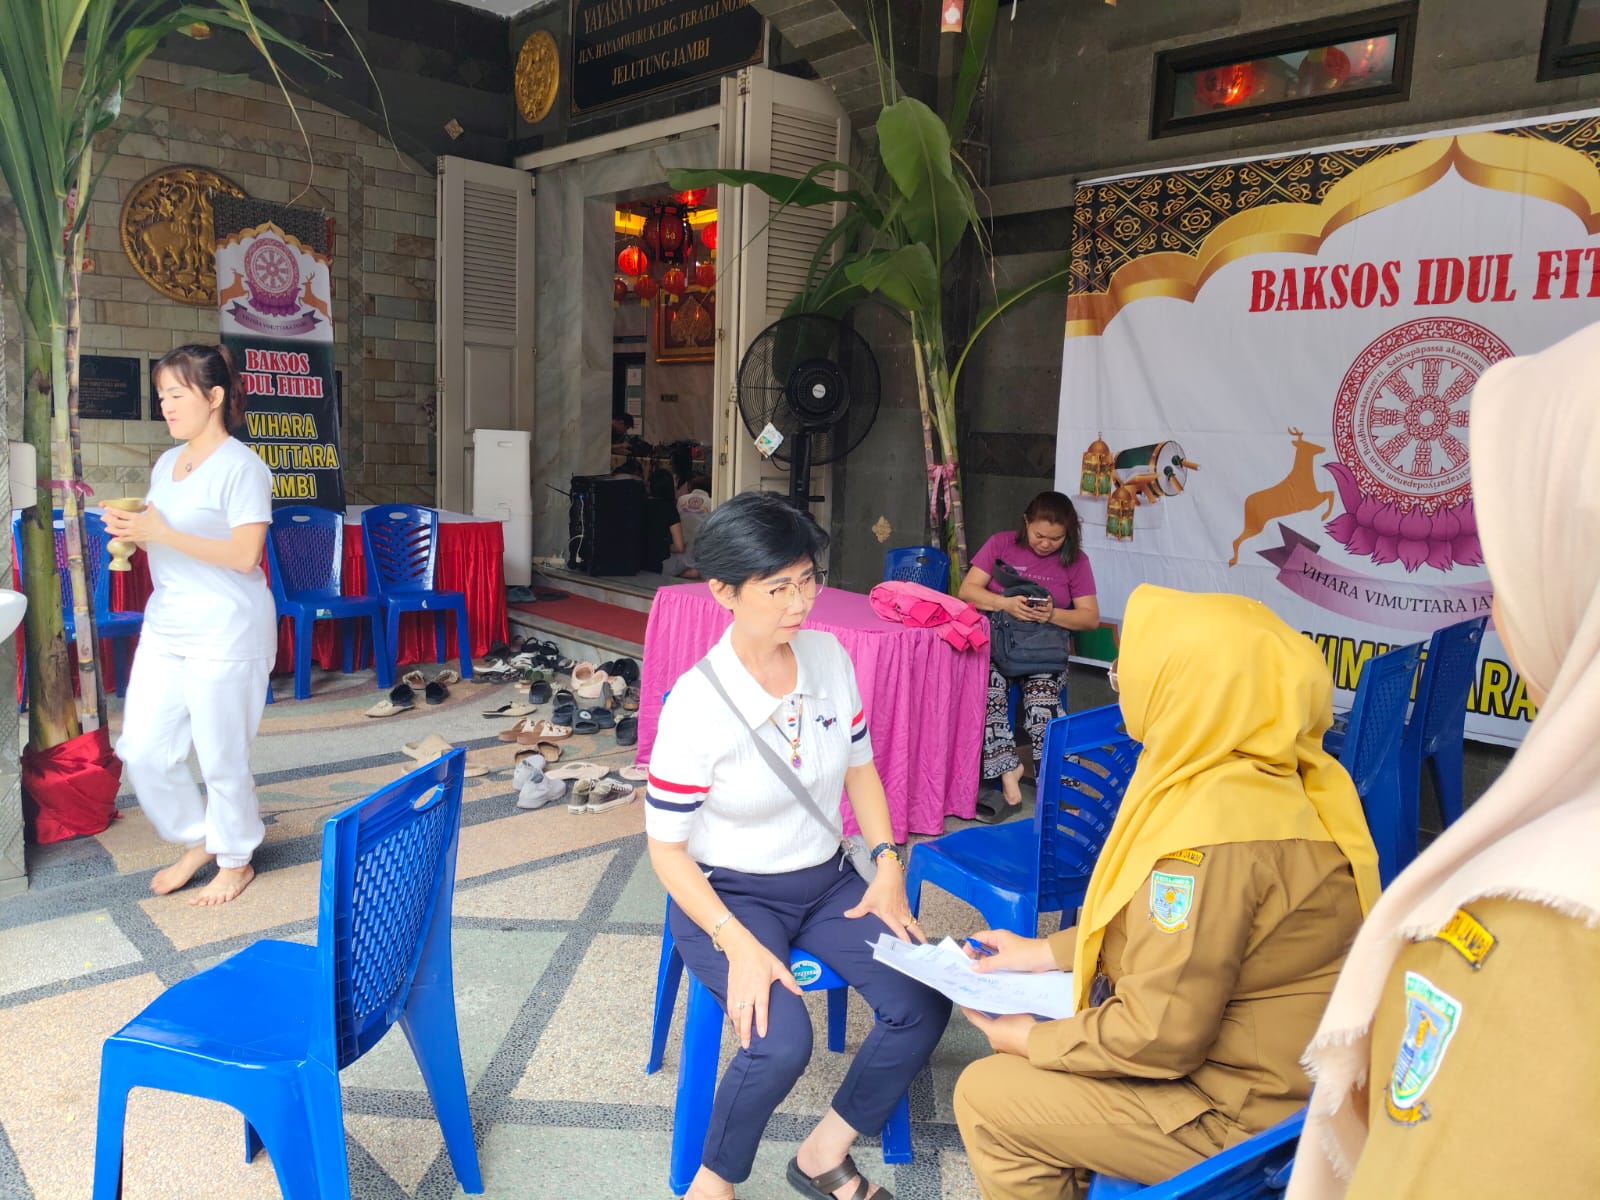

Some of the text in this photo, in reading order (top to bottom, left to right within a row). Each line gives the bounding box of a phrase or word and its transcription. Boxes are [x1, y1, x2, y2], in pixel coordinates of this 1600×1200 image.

[612, 37, 711, 86] JELUTUNG JAMBI
[1249, 260, 1401, 313] BAKSOS
[1413, 253, 1517, 306] IDUL
[245, 350, 309, 374] BAKSOS
[240, 373, 323, 397] DUL FITRI
[246, 412, 317, 438] VIHARA
[271, 474, 316, 499] AMBI
[1302, 562, 1359, 600] VIHARA
[1364, 589, 1468, 614] VIMUTTARA
